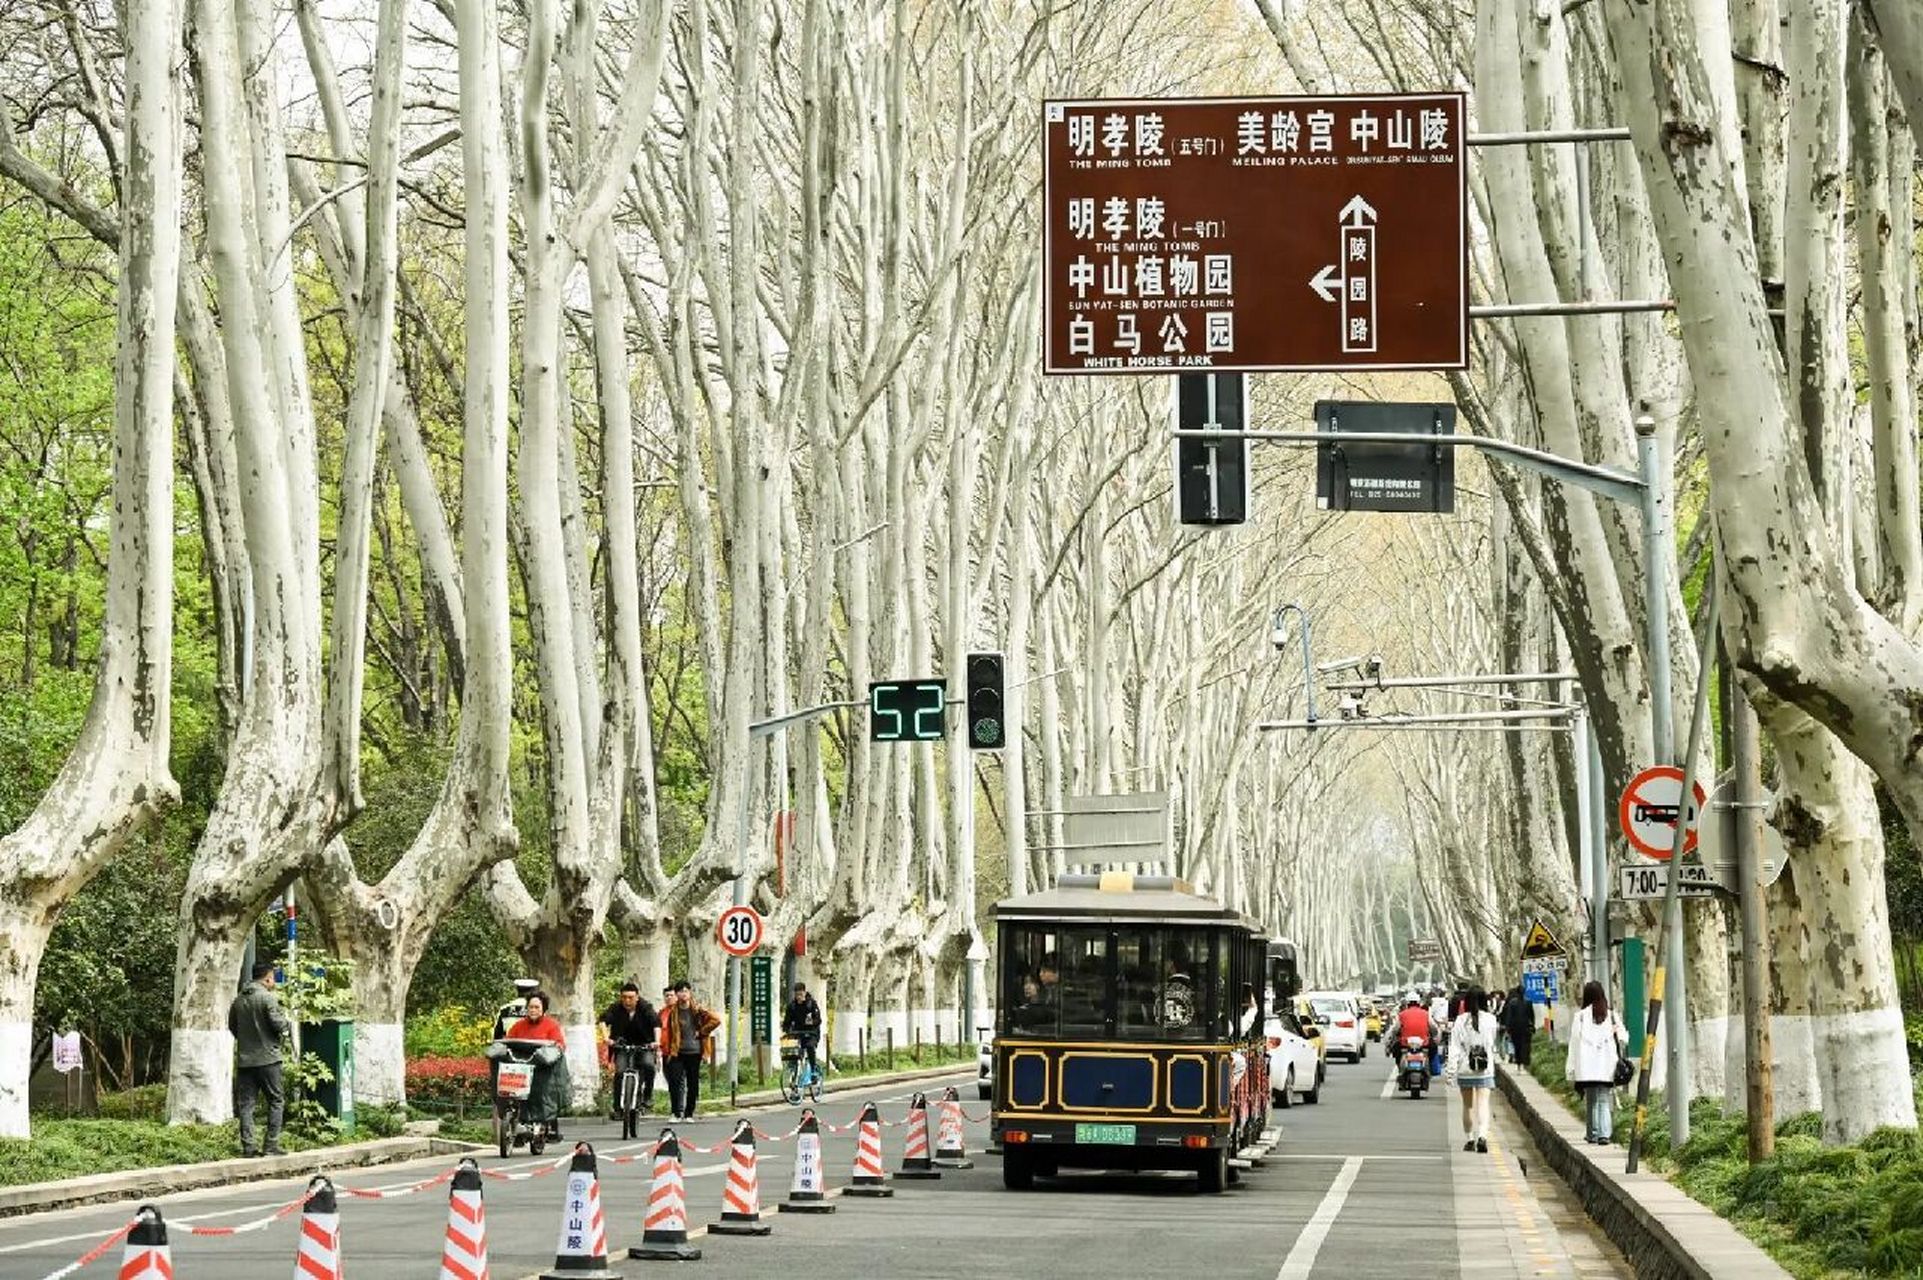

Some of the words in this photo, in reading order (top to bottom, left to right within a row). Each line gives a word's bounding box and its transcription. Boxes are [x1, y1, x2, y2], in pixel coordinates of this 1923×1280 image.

[1069, 113, 1165, 156] 明孝陵
[1237, 109, 1335, 155] 美龄宫
[1350, 107, 1449, 152] 中山陵
[1069, 160, 1092, 168] THE
[1096, 160, 1129, 168] MING
[1135, 158, 1172, 166] TOMB
[1232, 156, 1286, 166] MEILING
[1290, 156, 1339, 165] PALACE
[1069, 196, 1165, 240] 明孝陵
[1095, 243, 1120, 253] THE
[1124, 242, 1158, 252] MING
[1164, 241, 1200, 251] TOMB
[1069, 254, 1232, 298] 中山植物园
[1350, 237, 1367, 342] 陵园路
[1069, 301, 1091, 310] SUN
[1093, 300, 1139, 310] YAT-SEN
[1142, 299, 1188, 309] BOTANIC
[1190, 299, 1235, 309] GARDEN
[1069, 312, 1234, 355] 白马公园
[1083, 357, 1123, 367] WHITE
[1127, 355, 1173, 366] HORSE
[1178, 355, 1213, 366] PARK
[874, 685, 943, 738] 52
[727, 917, 753, 944] 30
[567, 1199, 584, 1249] 中山陵
